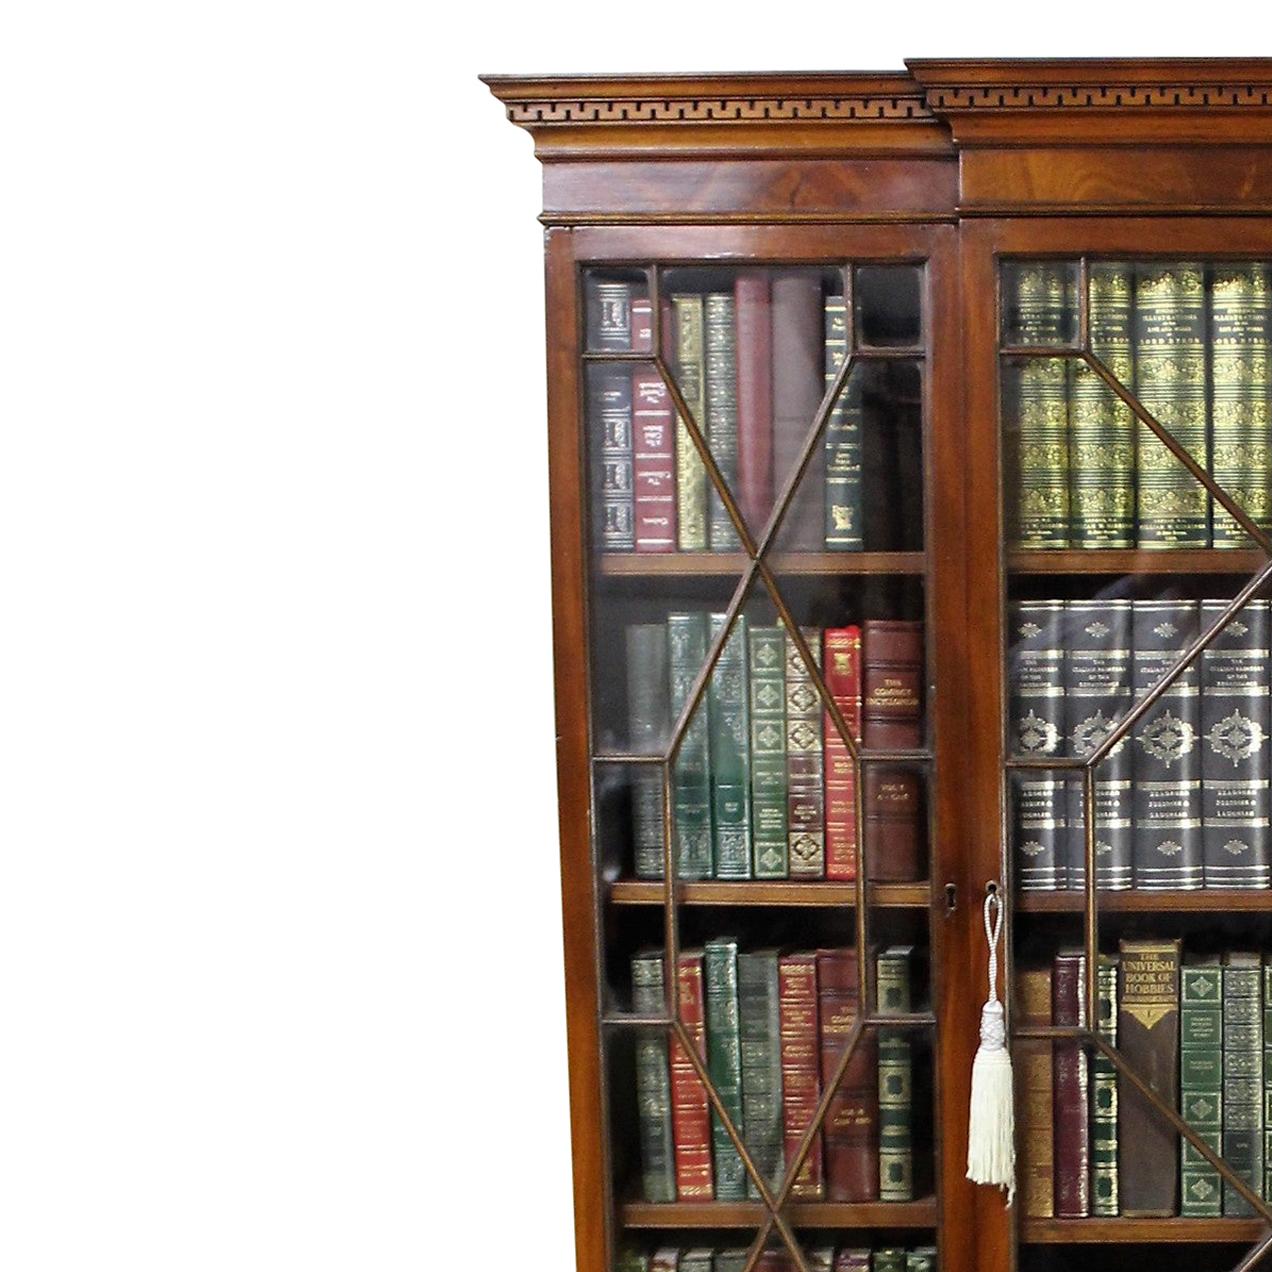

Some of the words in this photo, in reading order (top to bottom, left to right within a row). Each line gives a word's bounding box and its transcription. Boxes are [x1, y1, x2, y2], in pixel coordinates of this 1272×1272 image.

[1122, 960, 1176, 972] UNIVERSAL
[1125, 972, 1156, 983] BOOK
[1158, 972, 1172, 983] OF
[1124, 983, 1175, 993] HOBBIES
